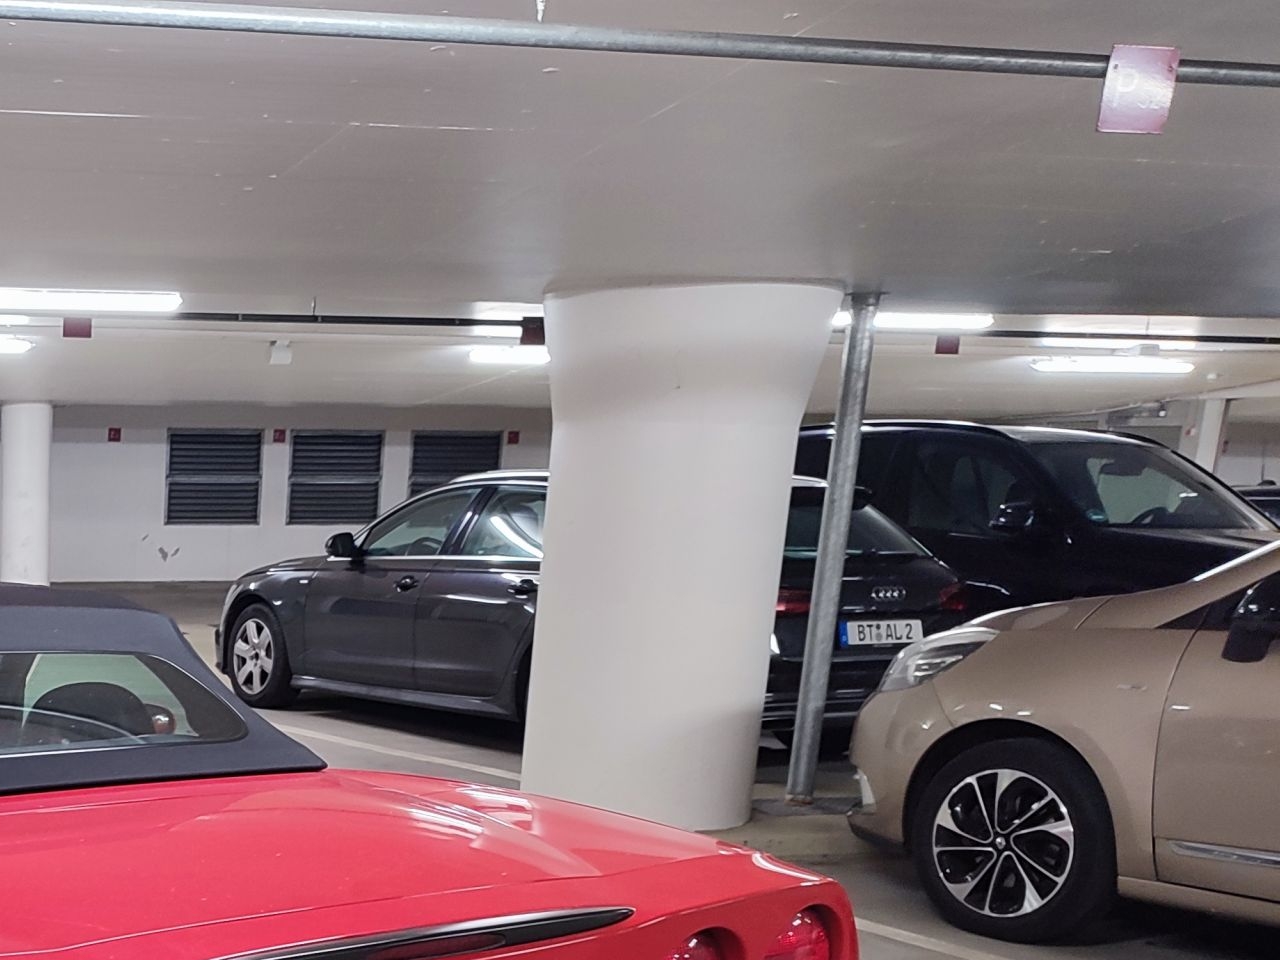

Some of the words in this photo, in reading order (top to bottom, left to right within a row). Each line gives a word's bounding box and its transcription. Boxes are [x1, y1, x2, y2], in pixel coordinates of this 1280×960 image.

[857, 624, 873, 641] BT
[885, 623, 902, 640] AL
[905, 623, 914, 640] 2
